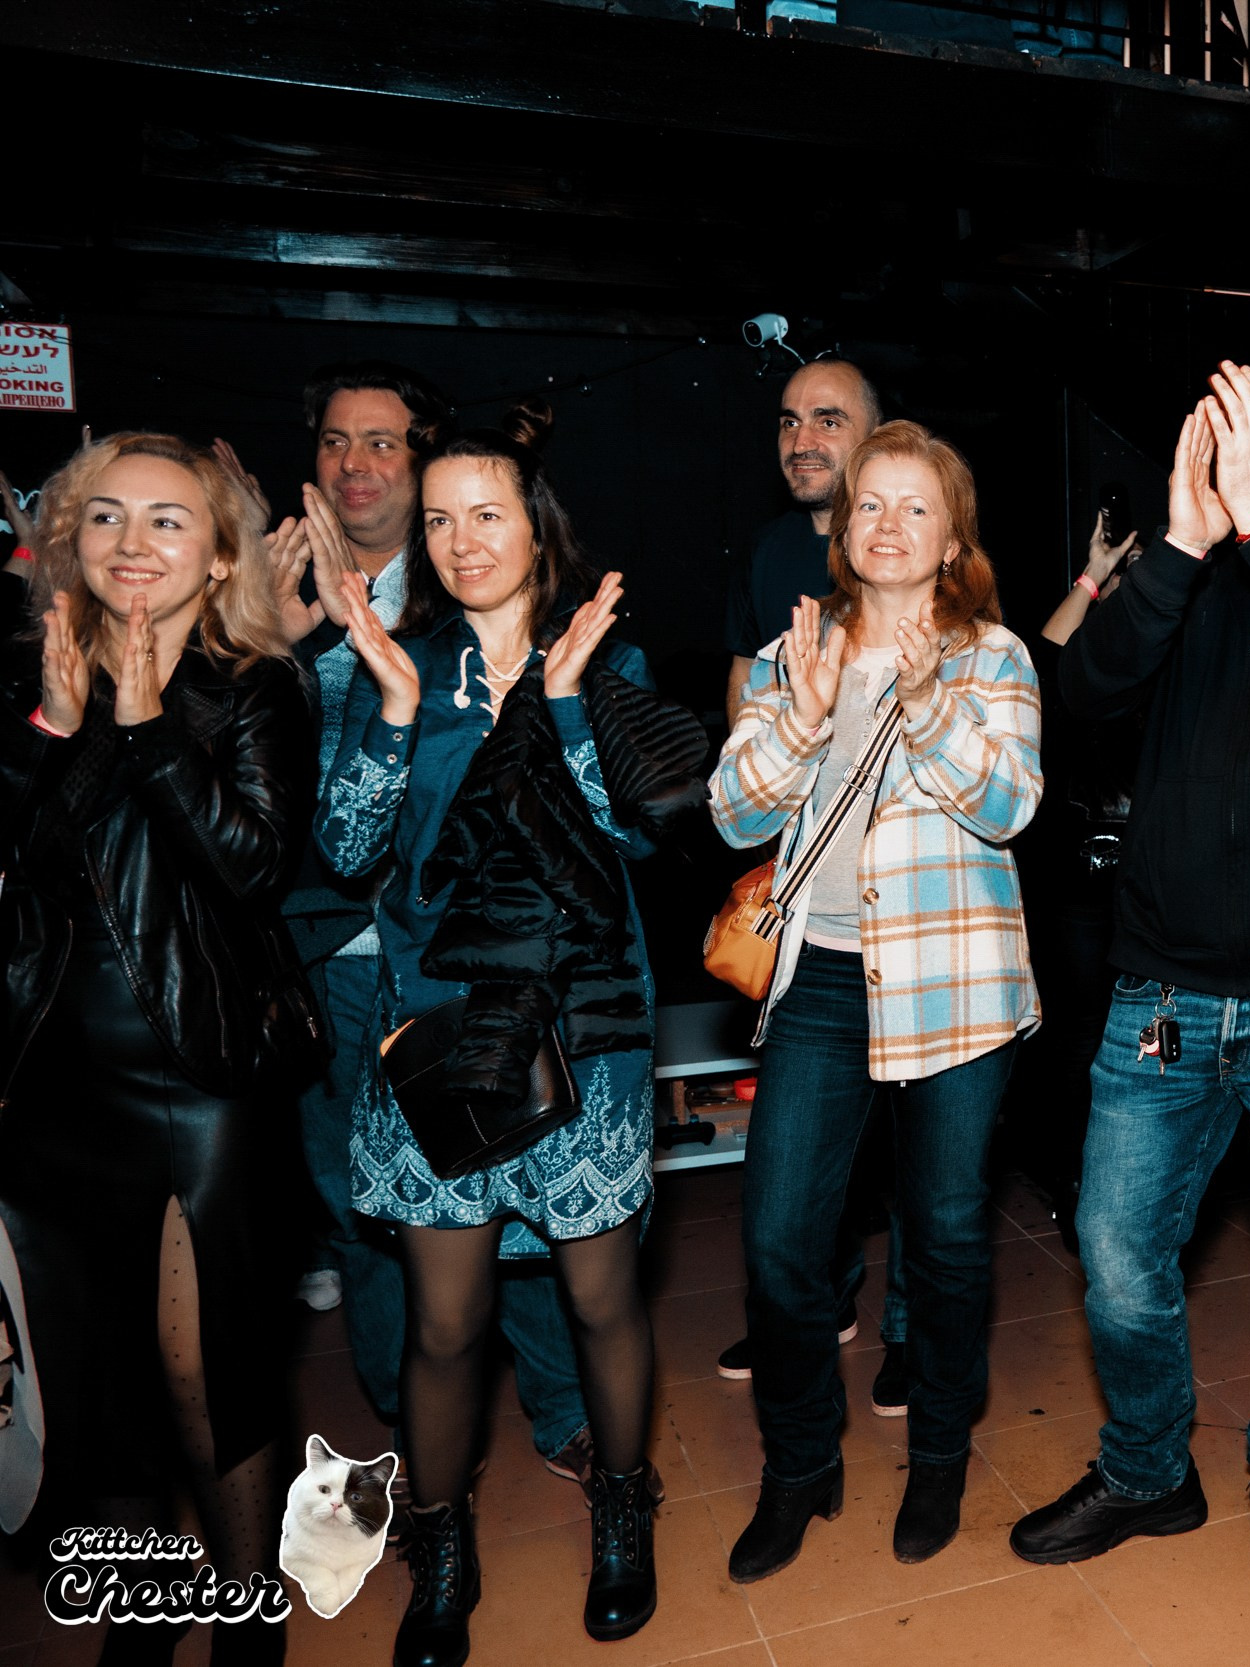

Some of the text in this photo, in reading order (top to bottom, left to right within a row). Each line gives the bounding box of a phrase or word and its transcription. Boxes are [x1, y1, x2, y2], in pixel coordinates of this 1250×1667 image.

[0, 326, 57, 340] אסו
[0, 362, 47, 376] التدخي
[0, 379, 64, 392] OKING
